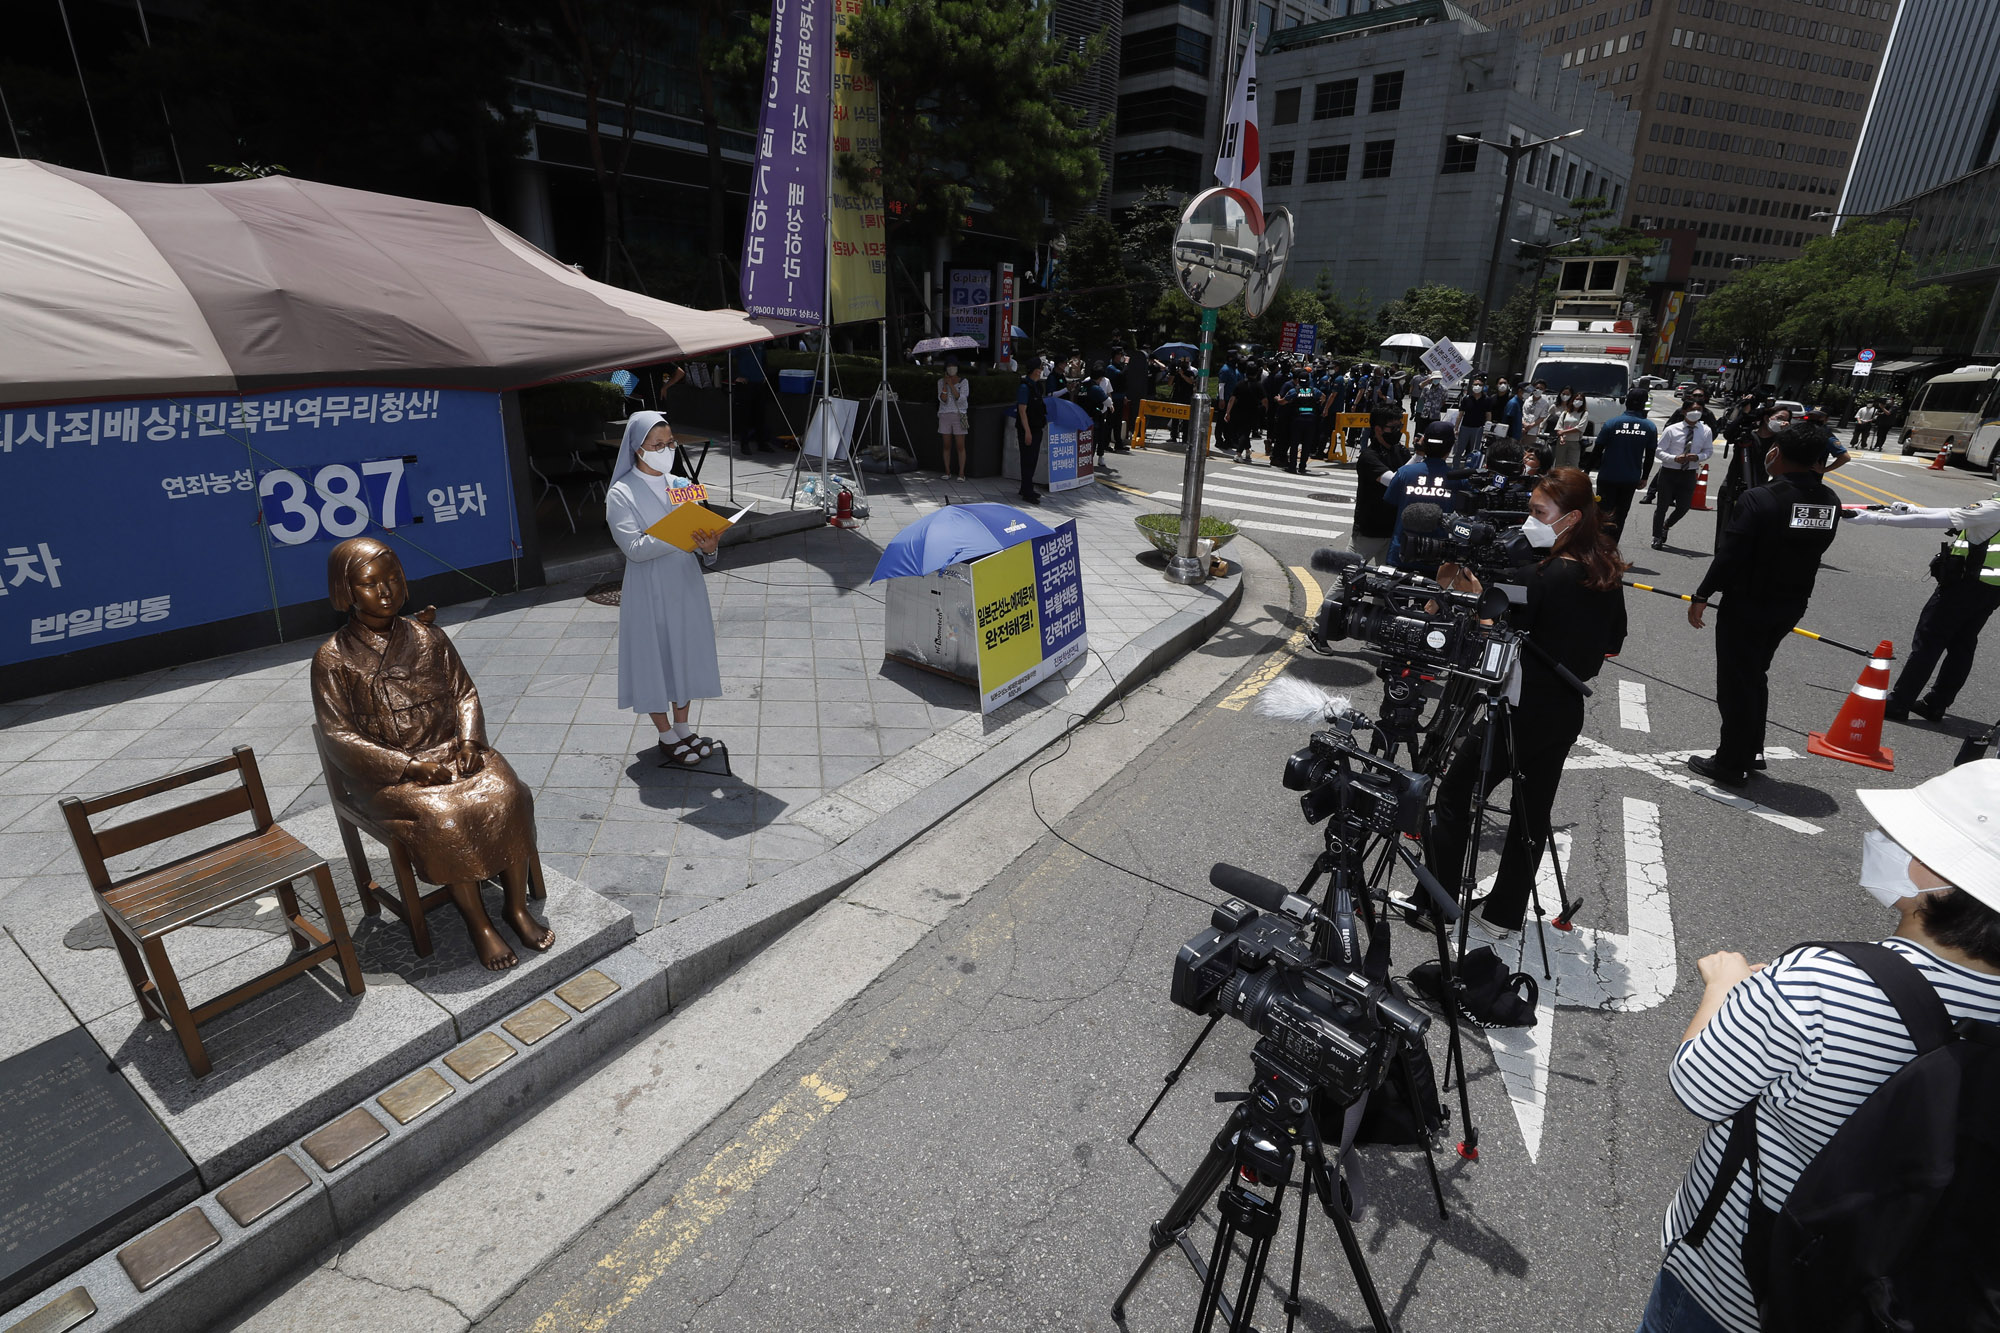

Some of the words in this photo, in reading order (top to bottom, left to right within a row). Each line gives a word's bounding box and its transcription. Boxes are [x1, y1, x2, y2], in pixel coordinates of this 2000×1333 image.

[973, 307, 988, 316] Bird
[1161, 406, 1188, 416] POLICE
[1615, 428, 1647, 436] POLICE
[161, 468, 254, 500] 연좌농성
[259, 458, 405, 546] 387
[426, 482, 488, 524] 일차
[1406, 485, 1452, 498] POLICE
[1455, 524, 1471, 537] KBS
[1797, 518, 1828, 527] POLICE
[1039, 530, 1074, 567] 일본정부
[1042, 556, 1076, 592] 군국주의
[1045, 582, 1079, 619] 부활책동
[30, 595, 171, 645] 반일행동
[984, 609, 1034, 650] 완전해결!
[1045, 606, 1082, 646] 강력규탄!
[1343, 928, 1351, 963] Canon
[1330, 1046, 1352, 1062] SONY
